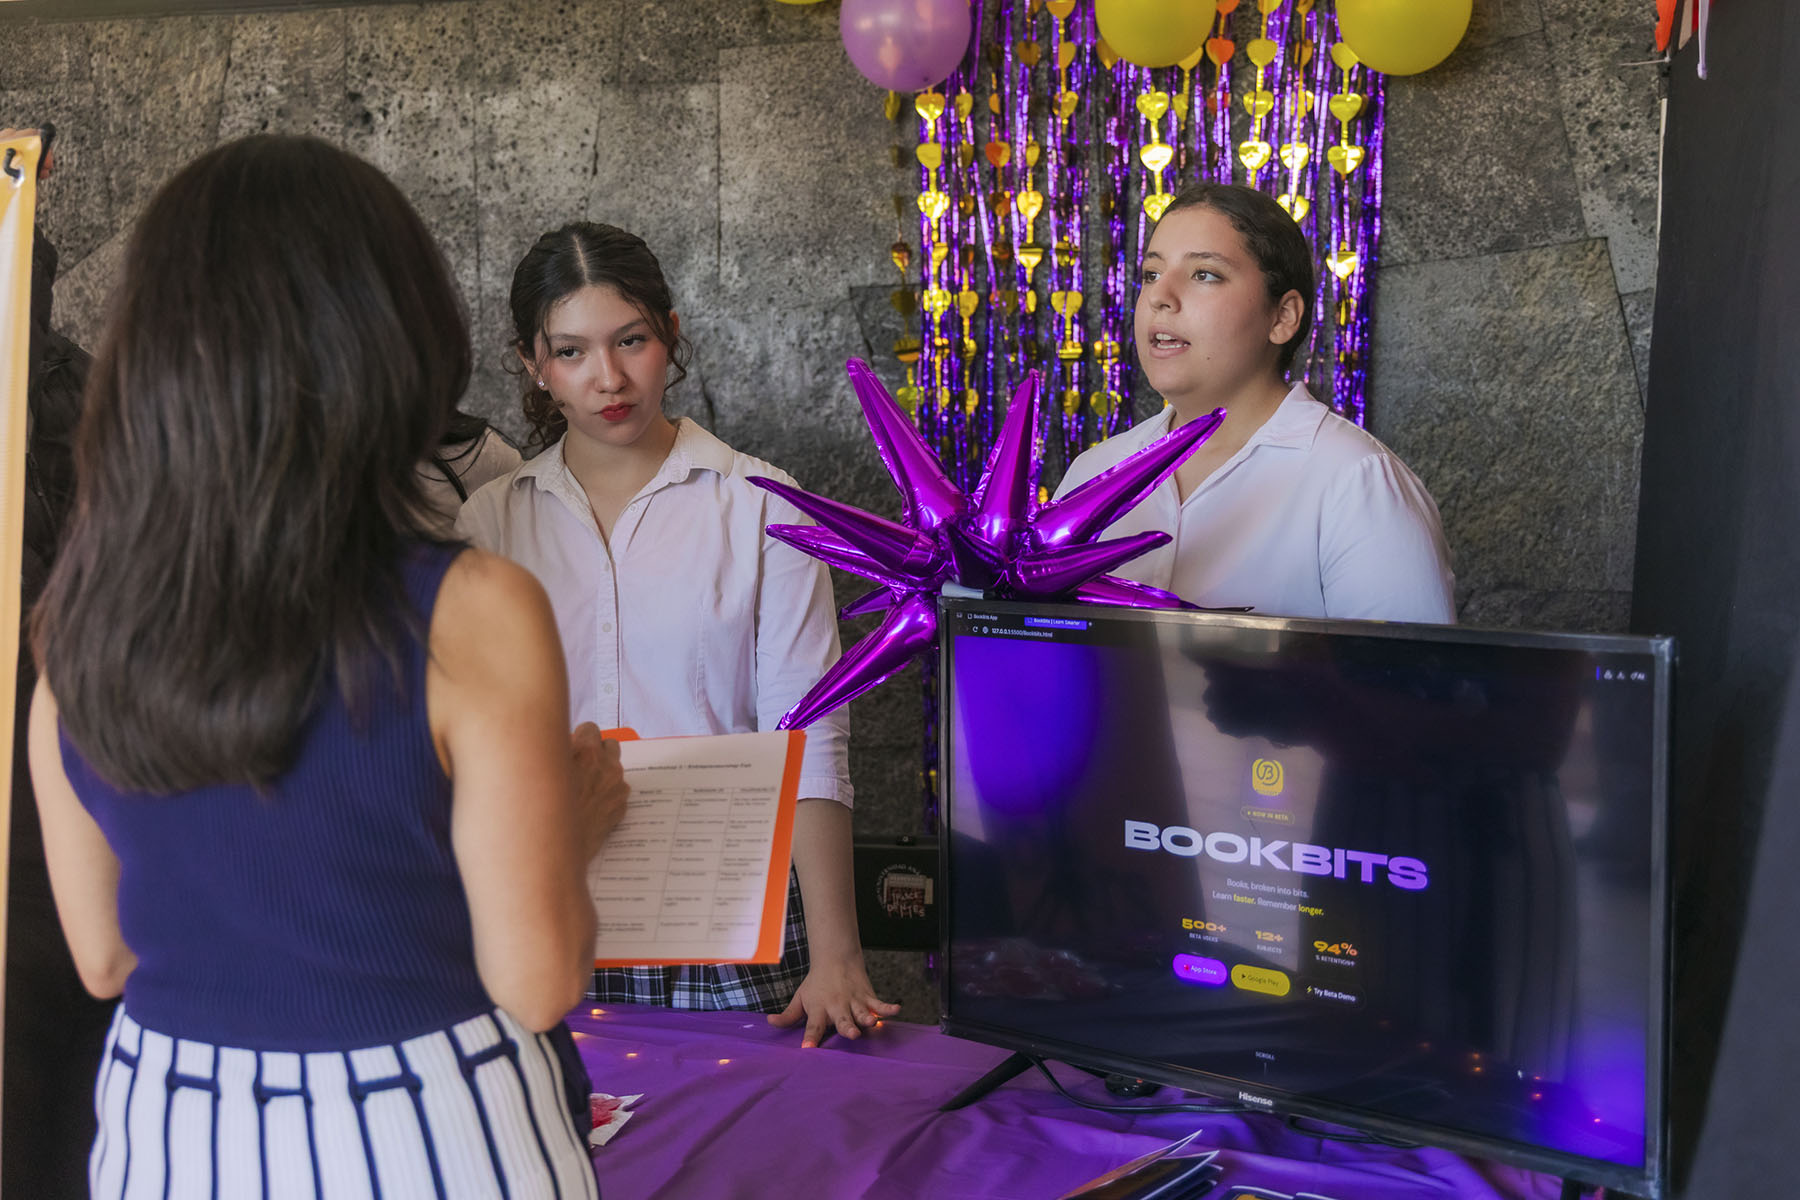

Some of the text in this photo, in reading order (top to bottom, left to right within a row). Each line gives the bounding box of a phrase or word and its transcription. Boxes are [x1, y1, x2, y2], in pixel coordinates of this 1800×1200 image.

[1124, 819, 1429, 891] BOOKBITS
[1226, 878, 1310, 899] Books, broken into bits.
[1212, 889, 1325, 917] Learn faster. Remember longer.
[1182, 917, 1227, 933] 500+
[1189, 932, 1202, 940] BETA
[1255, 930, 1284, 943] 12+
[1313, 940, 1359, 957] 94%
[1190, 964, 1218, 976] App Store
[1247, 973, 1267, 985] Google
[1313, 987, 1357, 1002] Try Beta Demo
[1238, 1090, 1273, 1106] Hisense
